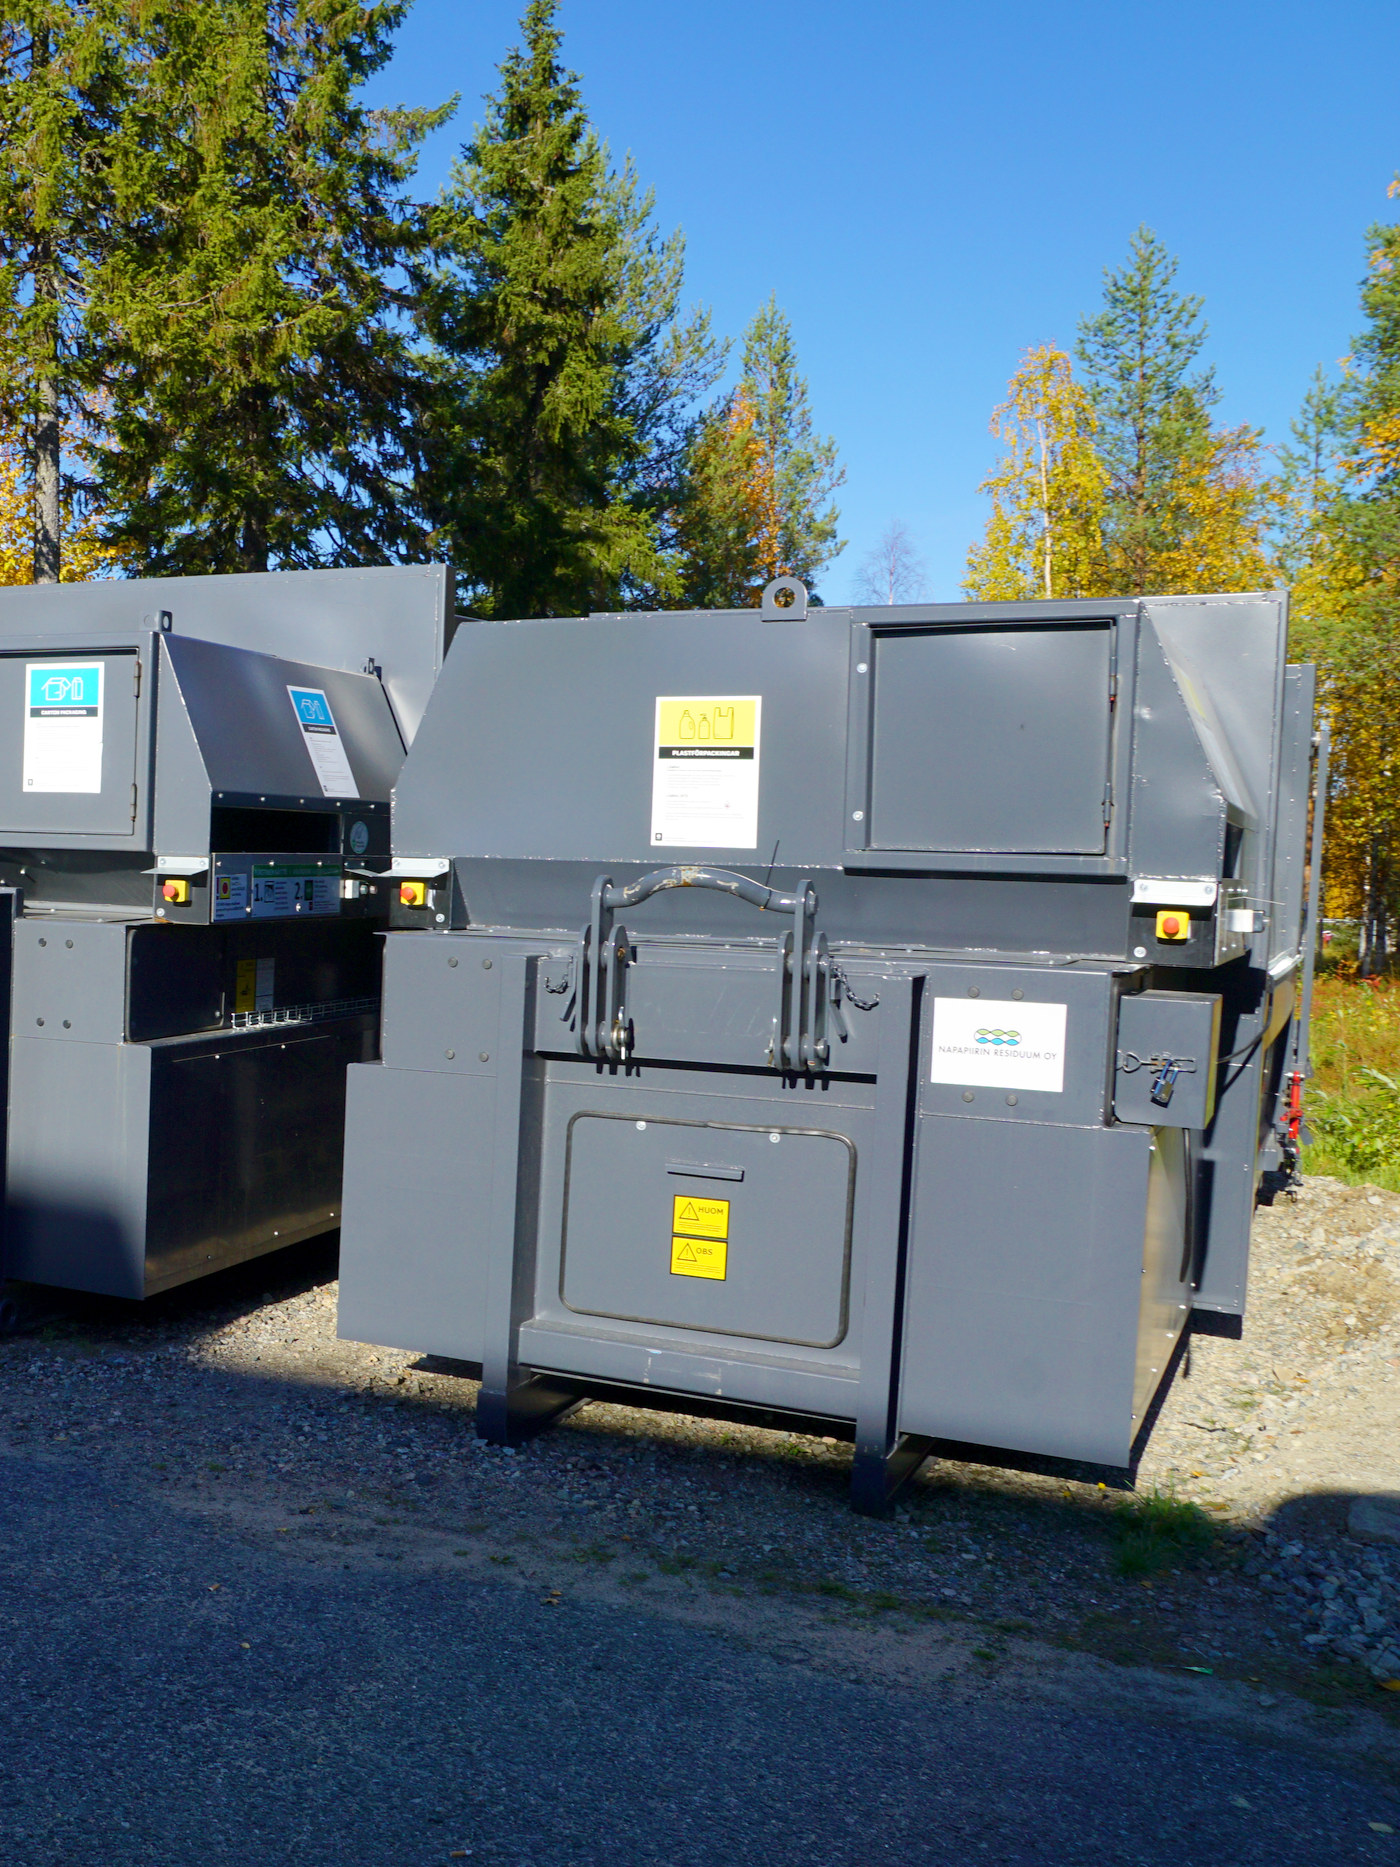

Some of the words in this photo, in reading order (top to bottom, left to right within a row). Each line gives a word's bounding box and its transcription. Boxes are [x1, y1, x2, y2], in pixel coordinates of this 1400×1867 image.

[938, 1046, 990, 1056] NAPAPIIRIN
[993, 1049, 1041, 1059] RESIDUUM
[1043, 1052, 1057, 1060] OY
[698, 1206, 724, 1215] HUOM
[696, 1247, 713, 1255] OBS
